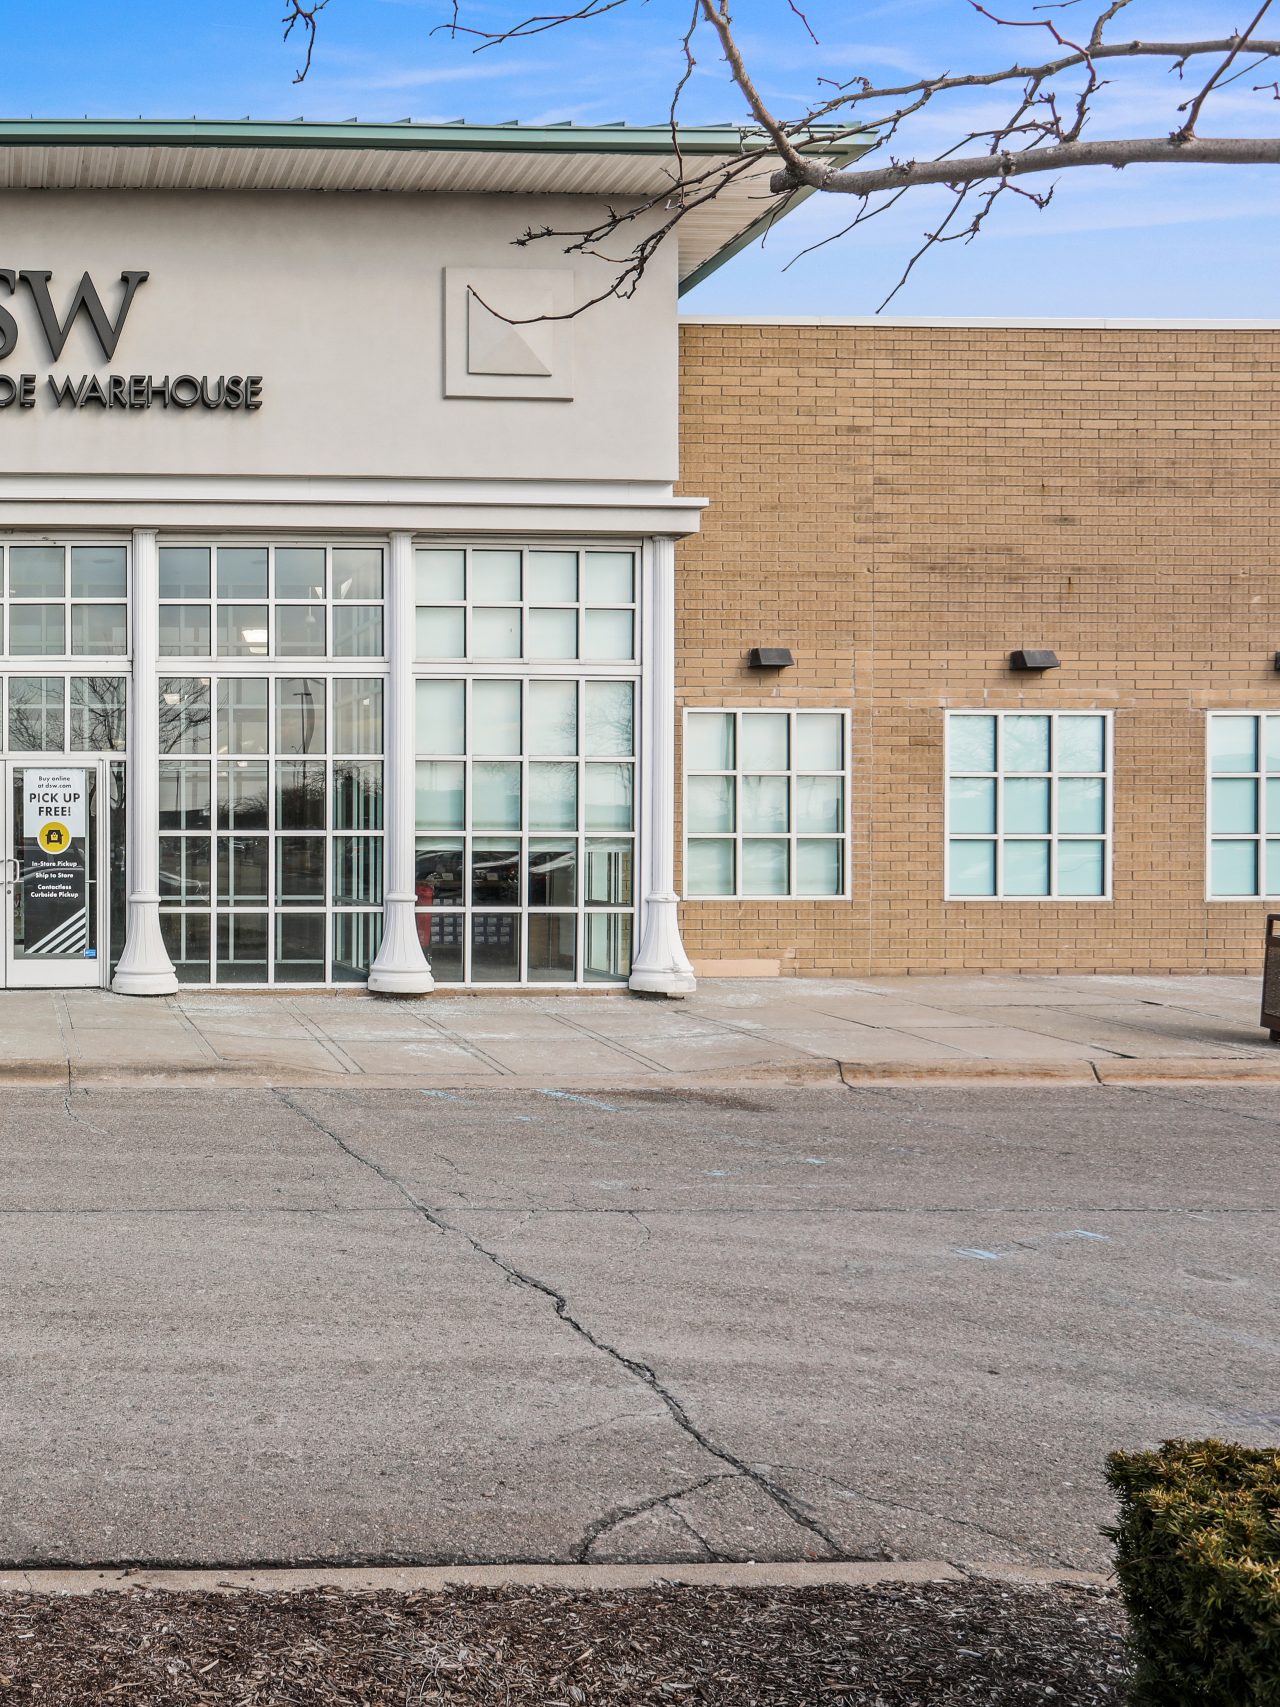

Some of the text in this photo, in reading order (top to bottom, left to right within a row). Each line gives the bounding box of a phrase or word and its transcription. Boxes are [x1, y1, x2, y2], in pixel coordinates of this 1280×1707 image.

[48, 374, 263, 409] WAREHOUSE
[29, 792, 81, 803] PICK UP
[38, 806, 71, 816] FREE!
[57, 860, 78, 868] Pickup
[35, 872, 49, 880] Ship
[58, 891, 79, 899] Pickup
